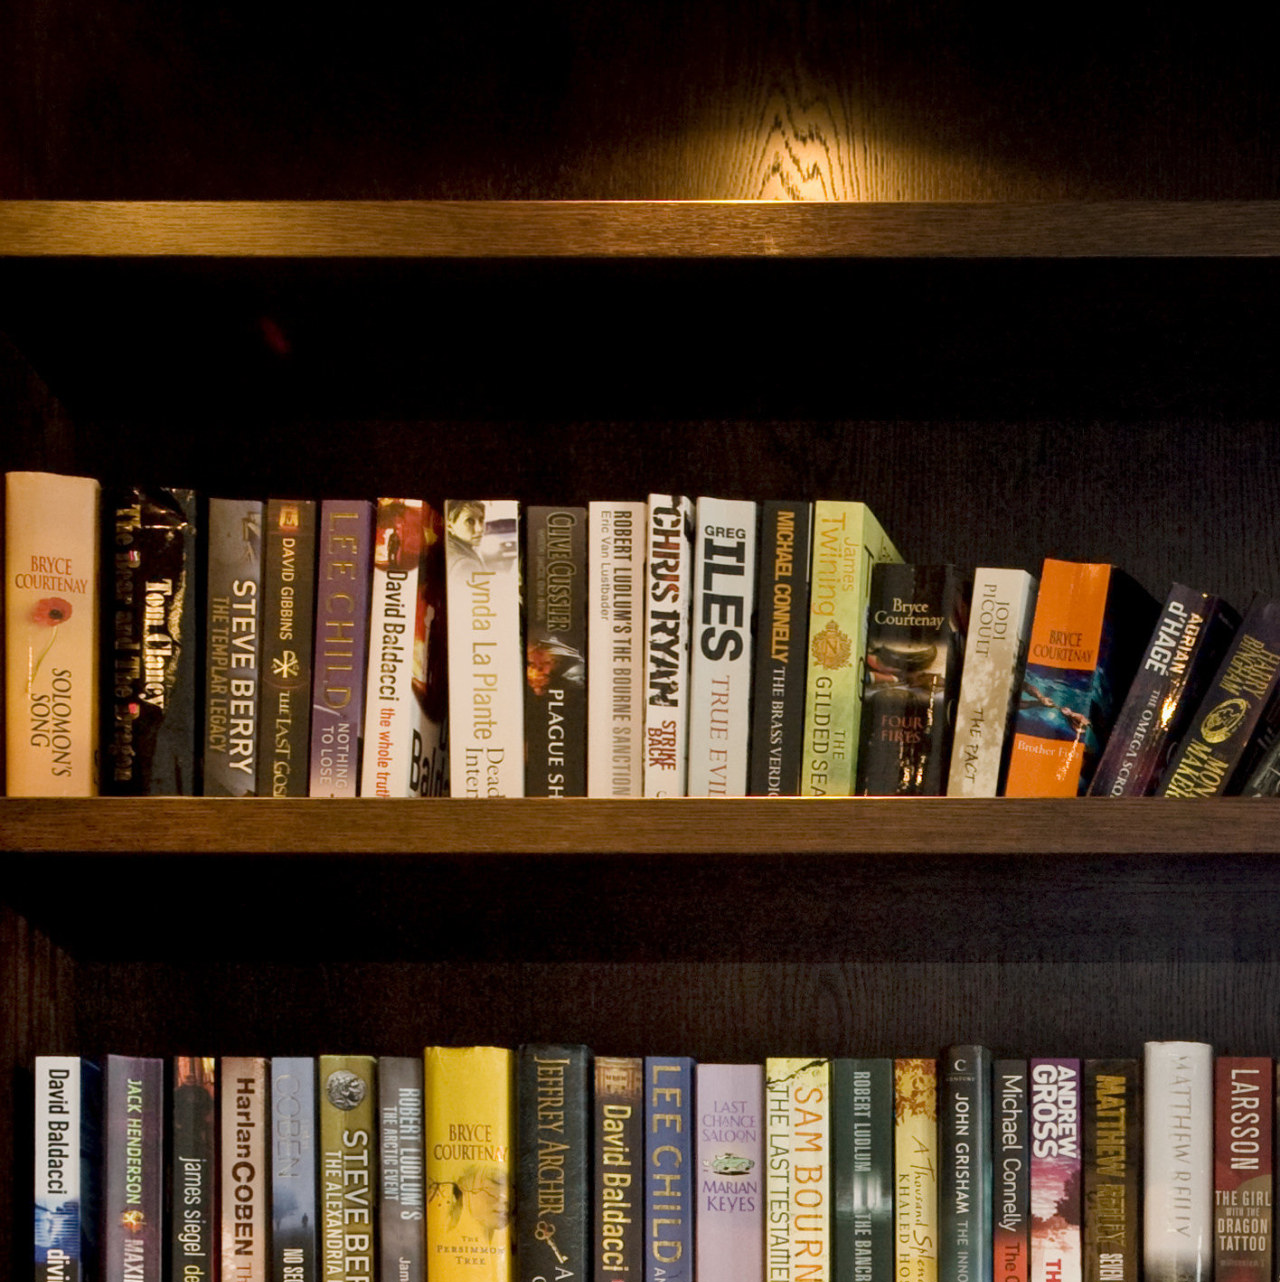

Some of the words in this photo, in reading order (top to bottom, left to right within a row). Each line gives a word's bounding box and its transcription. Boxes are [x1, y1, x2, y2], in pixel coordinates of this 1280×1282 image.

[327, 512, 359, 581] LEE
[613, 511, 632, 562] ROBERT
[650, 507, 681, 604] CHRIS
[704, 525, 747, 540] GREG
[774, 511, 795, 581] MICHAEL
[15, 573, 88, 594] COURTENAY
[31, 555, 72, 575] BRYCE
[281, 538, 295, 582] DAVID
[813, 512, 847, 617] Twining
[842, 537, 859, 592] James
[212, 597, 229, 630] THE
[279, 586, 294, 640] GIBBINS
[384, 570, 408, 618] David
[466, 570, 497, 631] Lynda
[613, 567, 632, 633] LUDLUM'S
[700, 538, 746, 662] ILES
[874, 610, 944, 630] Courtenay
[892, 598, 929, 617] Bryce
[975, 583, 998, 658] PICOULT
[992, 600, 1010, 640] JODI
[232, 579, 257, 668] STEVE
[613, 637, 632, 663] THE
[771, 583, 791, 664] CONNELLY
[1049, 629, 1083, 647] BRYCE
[210, 634, 229, 697] TEMPLAR
[324, 594, 355, 709] CHILD
[379, 623, 405, 702] Baldacci
[472, 643, 497, 667] La
[649, 610, 681, 708] RYAN
[1032, 644, 1093, 663] COURTENAY
[30, 694, 50, 748] SONG
[472, 674, 498, 740] Plante
[613, 667, 632, 722] BOURNE
[52, 668, 72, 777] SOLOMON'S
[208, 700, 227, 752] LEGACY
[229, 680, 255, 775] BERRY
[322, 726, 333, 744] TO
[648, 727, 663, 767] BACK
[661, 720, 676, 771] STRIKE
[832, 729, 845, 760] THE
[319, 747, 333, 784] LOSE
[335, 723, 350, 789] NOTHING
[611, 725, 632, 797] SANCTION
[48, 1068, 70, 1115] David
[127, 1078, 143, 1113] JACK
[398, 1087, 422, 1142] ROBERT
[534, 1057, 571, 1134] JEFFREY
[652, 1065, 682, 1134] LEE
[713, 1100, 747, 1113] LAST
[769, 1086, 790, 1126] THE
[853, 1071, 871, 1118] ROBERT
[1001, 1074, 1023, 1151] Michael
[1032, 1064, 1058, 1159] GROSS
[1056, 1064, 1078, 1159] ANDREW
[449, 1124, 492, 1142] BRYCE
[602, 1105, 632, 1167] David
[702, 1115, 756, 1128] CHANCE
[702, 1130, 756, 1143] SALOON
[794, 1086, 824, 1153] SAM
[1230, 1069, 1260, 1171] LARSSON
[47, 1120, 70, 1195] Baldacci
[126, 1118, 141, 1205] HENDERSON
[324, 1150, 342, 1177] THE
[433, 1144, 509, 1161] COURTENAY
[769, 1134, 790, 1187] LAST
[853, 1123, 872, 1172] LUDLUM
[179, 1156, 207, 1205] james
[343, 1129, 370, 1224] STEVE
[399, 1146, 423, 1221] LUDLUM'S
[537, 1138, 571, 1218] ARCHER
[702, 1181, 758, 1194] MARIAN
[999, 1158, 1023, 1233] Connelly
[1216, 1191, 1238, 1206] THE
[1242, 1191, 1272, 1206] GIRL
[325, 1180, 343, 1276] ALEXANDRIA
[602, 1173, 632, 1273] Baldacci
[652, 1145, 682, 1264] CHILD
[706, 1196, 756, 1213] KEYES
[1218, 1218, 1268, 1234] DRAGON
[178, 1209, 206, 1257] siegel
[1219, 1236, 1266, 1251] TATTOO
